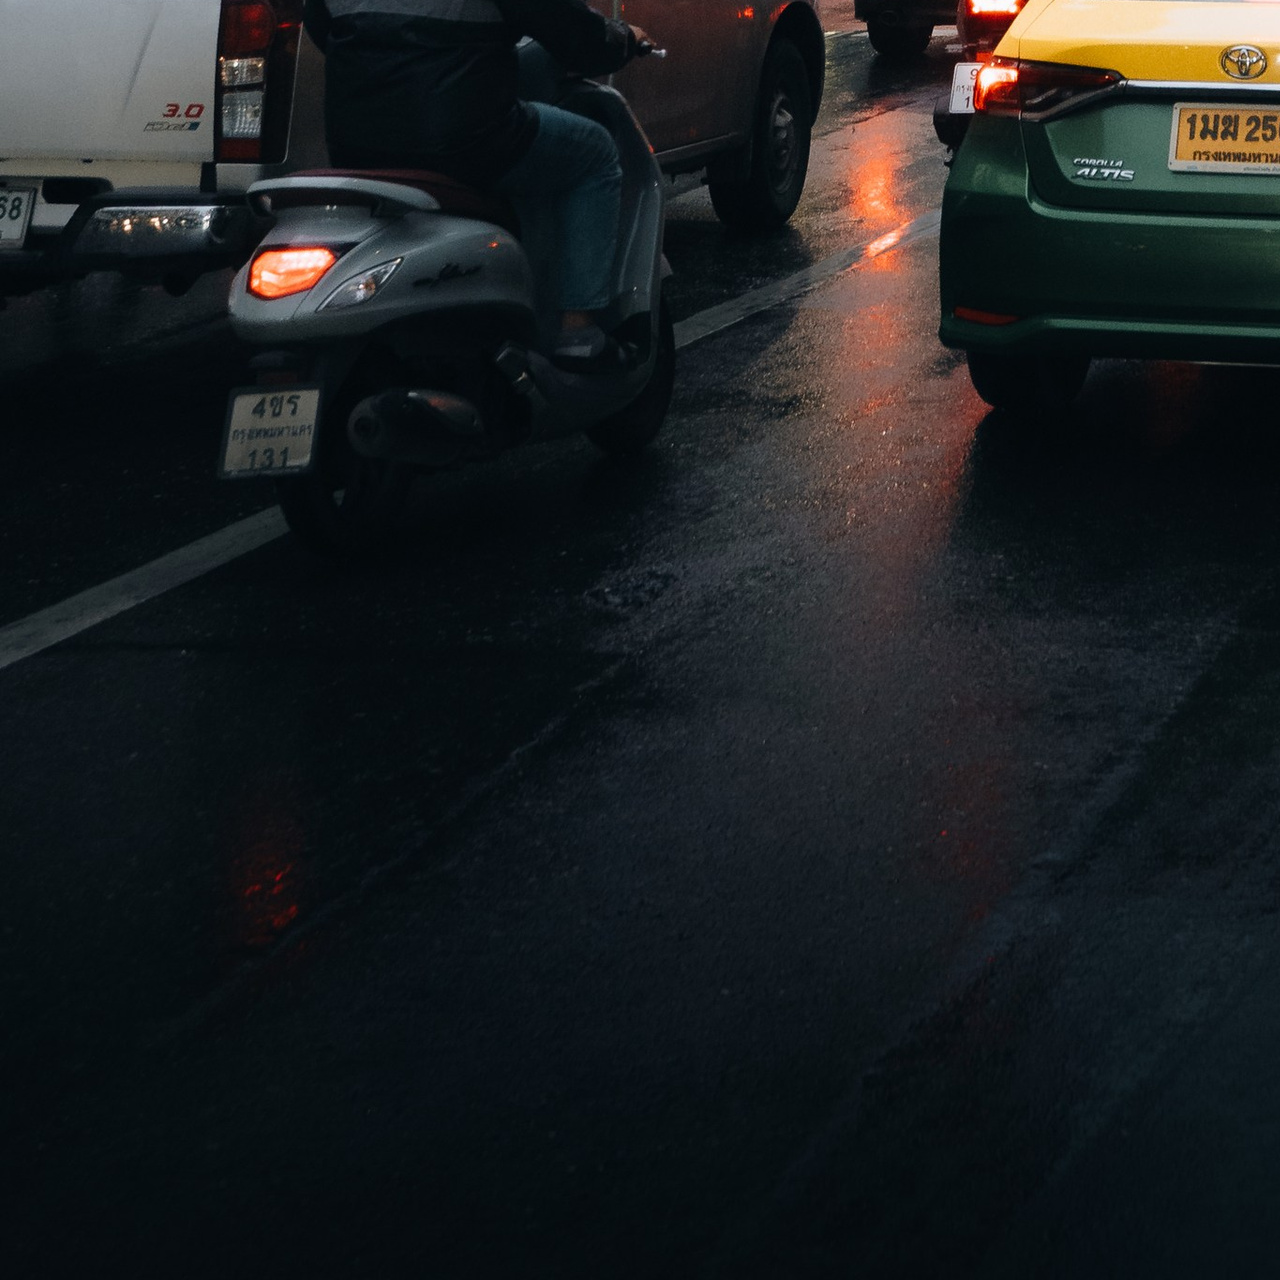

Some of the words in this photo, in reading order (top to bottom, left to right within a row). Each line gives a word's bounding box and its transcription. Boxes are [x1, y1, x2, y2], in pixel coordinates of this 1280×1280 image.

[162, 103, 205, 119] 3.0
[1072, 157, 1124, 168] COROLLA
[1076, 167, 1135, 181] ALTIS
